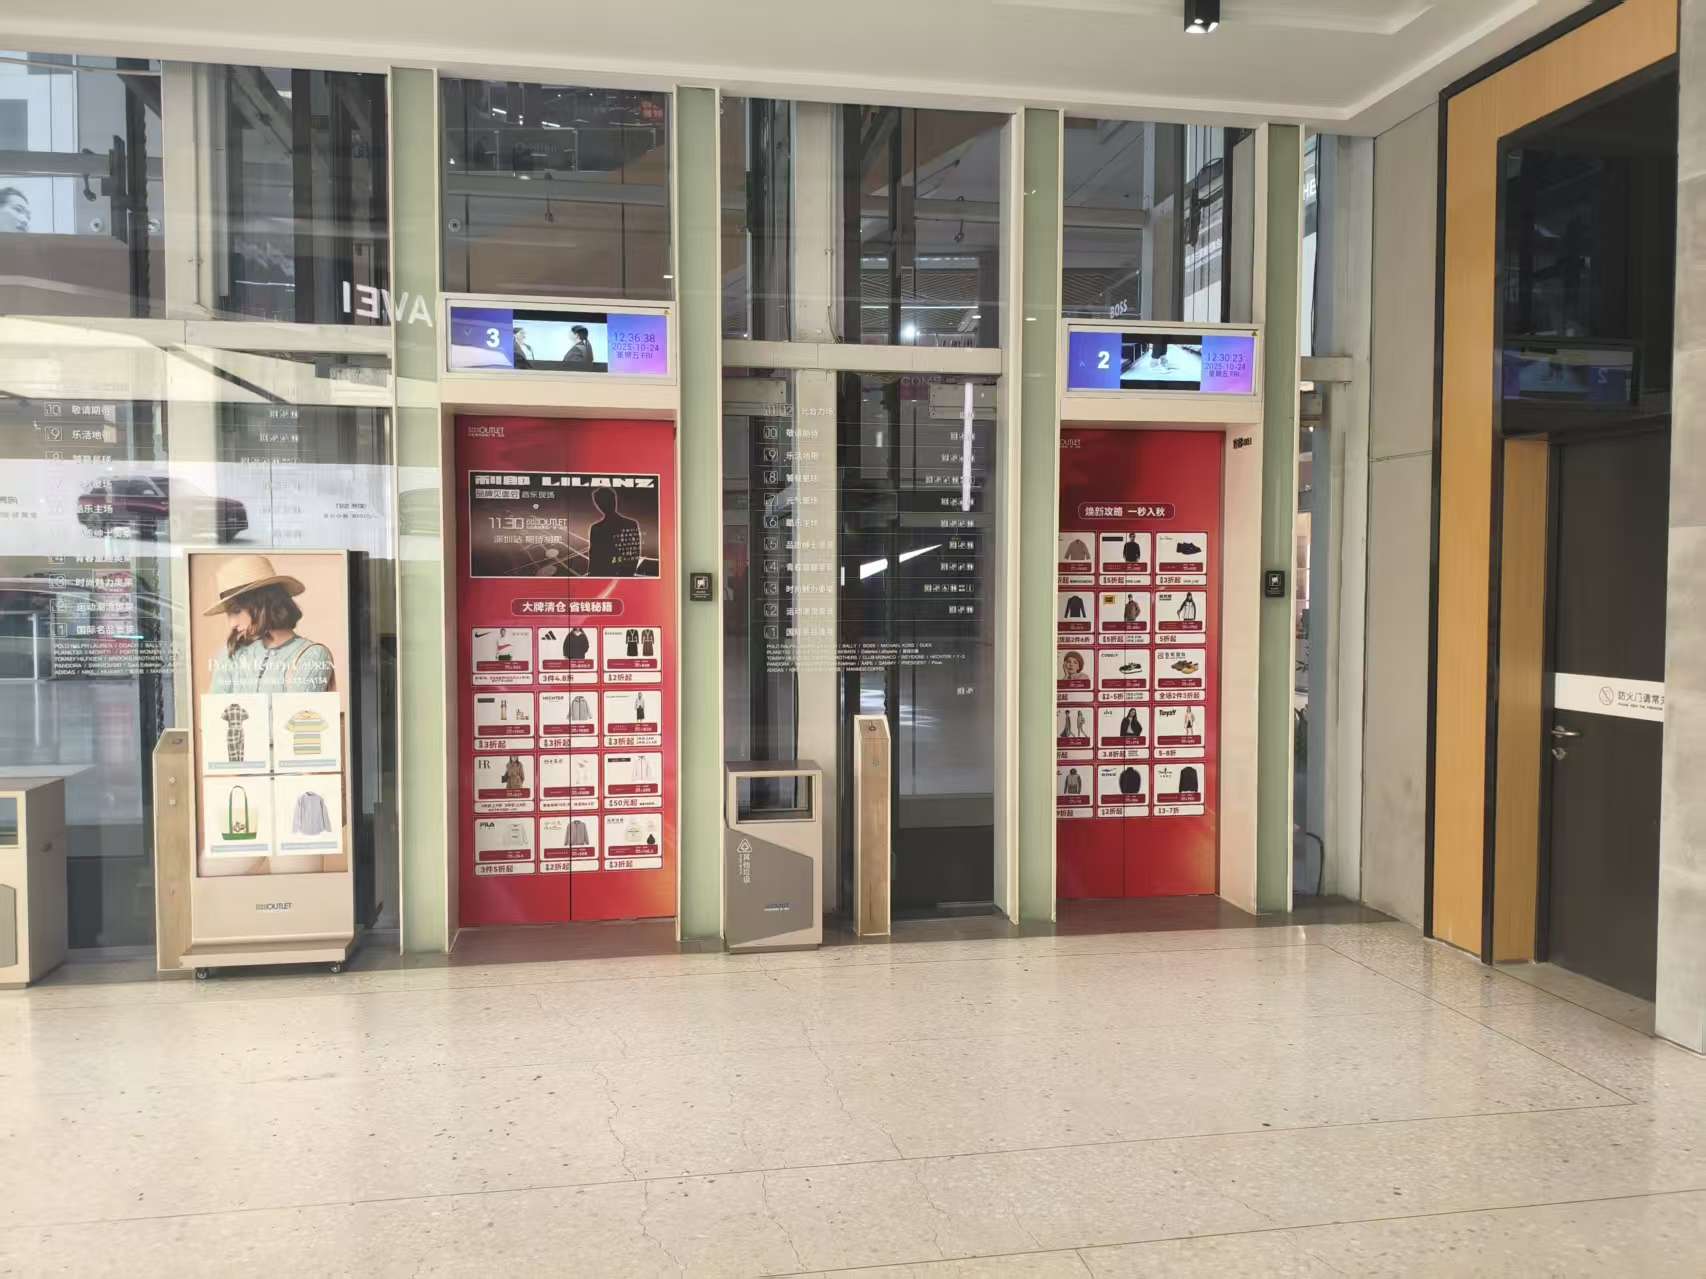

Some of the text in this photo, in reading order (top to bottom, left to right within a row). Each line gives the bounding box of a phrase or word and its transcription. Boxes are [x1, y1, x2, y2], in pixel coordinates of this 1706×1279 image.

[1110, 299, 1128, 319] BOSS
[485, 328, 500, 348] 3
[1097, 351, 1110, 369] 2
[541, 476, 655, 488] LILANZ
[1127, 506, 1165, 517] 一秒入秋
[522, 601, 613, 613] 大牌清仓 省钱秘籍
